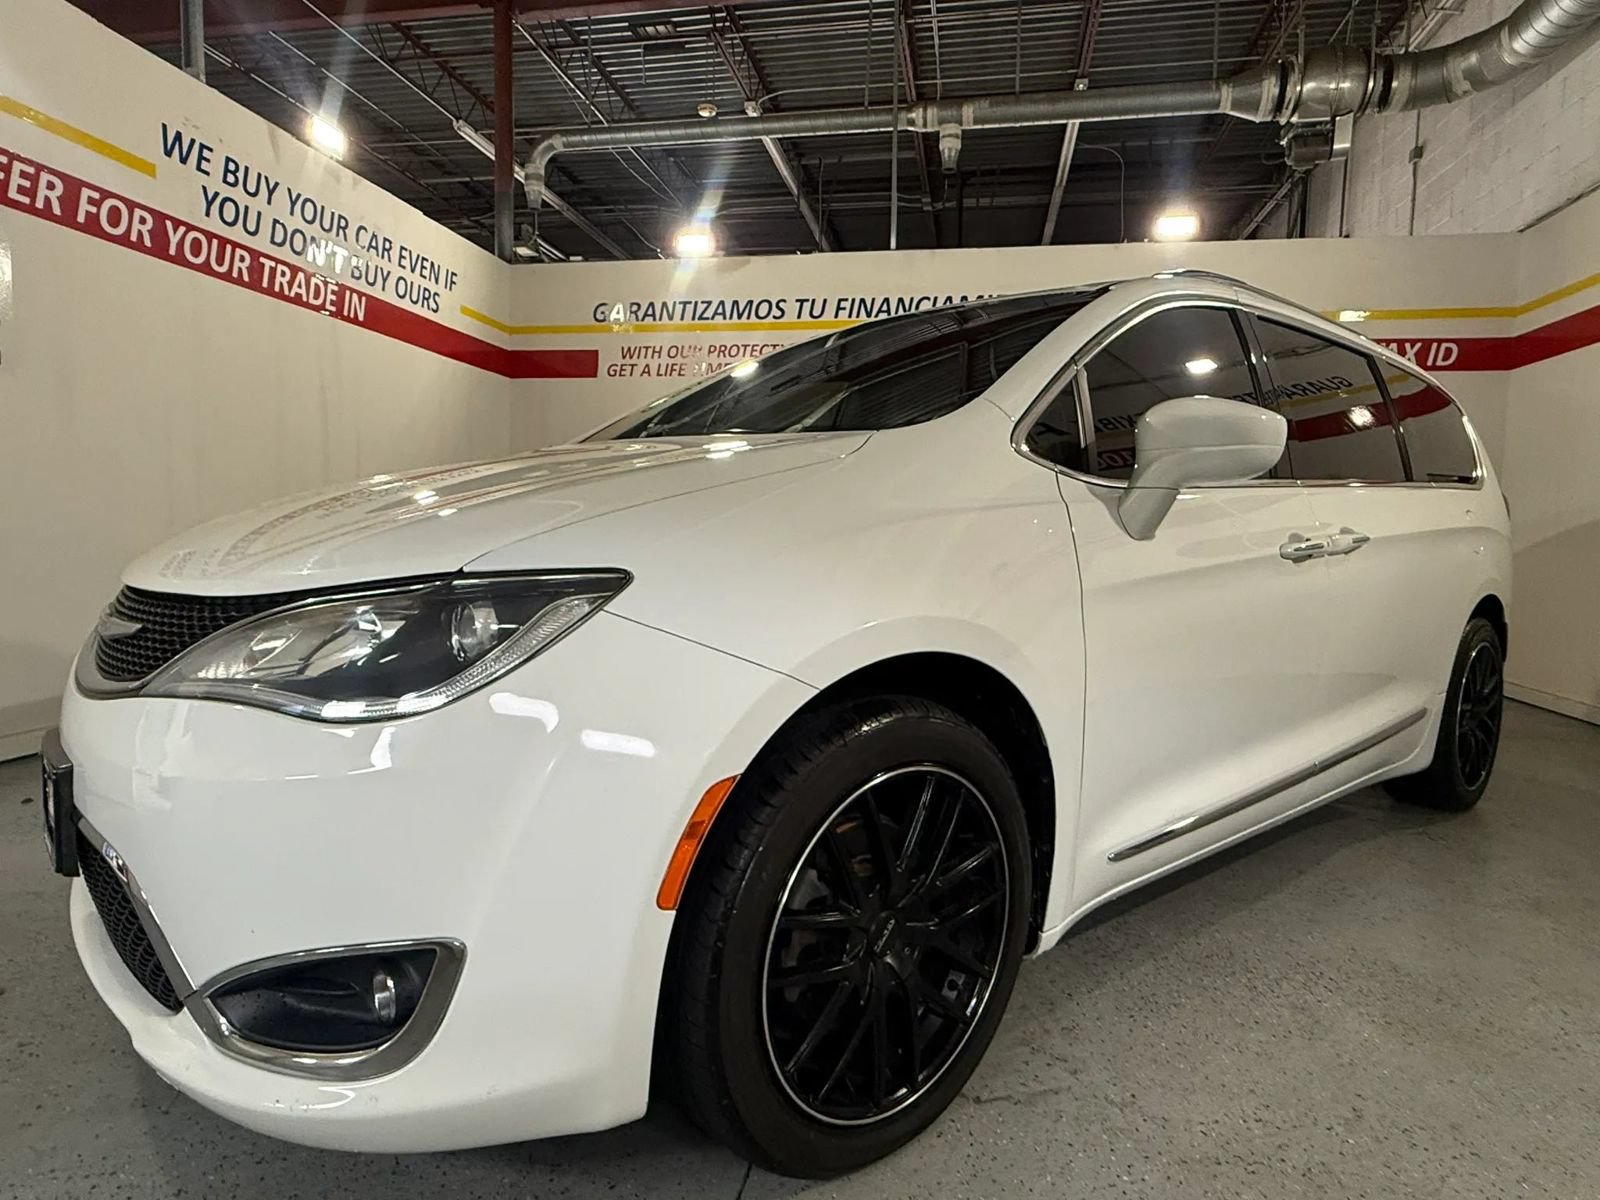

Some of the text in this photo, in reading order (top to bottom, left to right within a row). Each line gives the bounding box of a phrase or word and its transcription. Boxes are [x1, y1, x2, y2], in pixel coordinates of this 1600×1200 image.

[161, 122, 458, 292] WE BUY YOUR CAR EVEN IF
[76, 186, 154, 248] FOR
[164, 219, 250, 287] YOUR
[259, 257, 339, 312] TRADE
[343, 289, 366, 322] IN
[201, 184, 441, 314] YOU DON'T BUY OURS
[593, 298, 787, 323] GARANTIZAMOS
[795, 298, 827, 320] TU
[621, 345, 663, 360] WITH
[1426, 342, 1458, 367] ID
[607, 362, 638, 378] GET
[640, 363, 652, 377] A
[656, 362, 687, 377] LIFE
